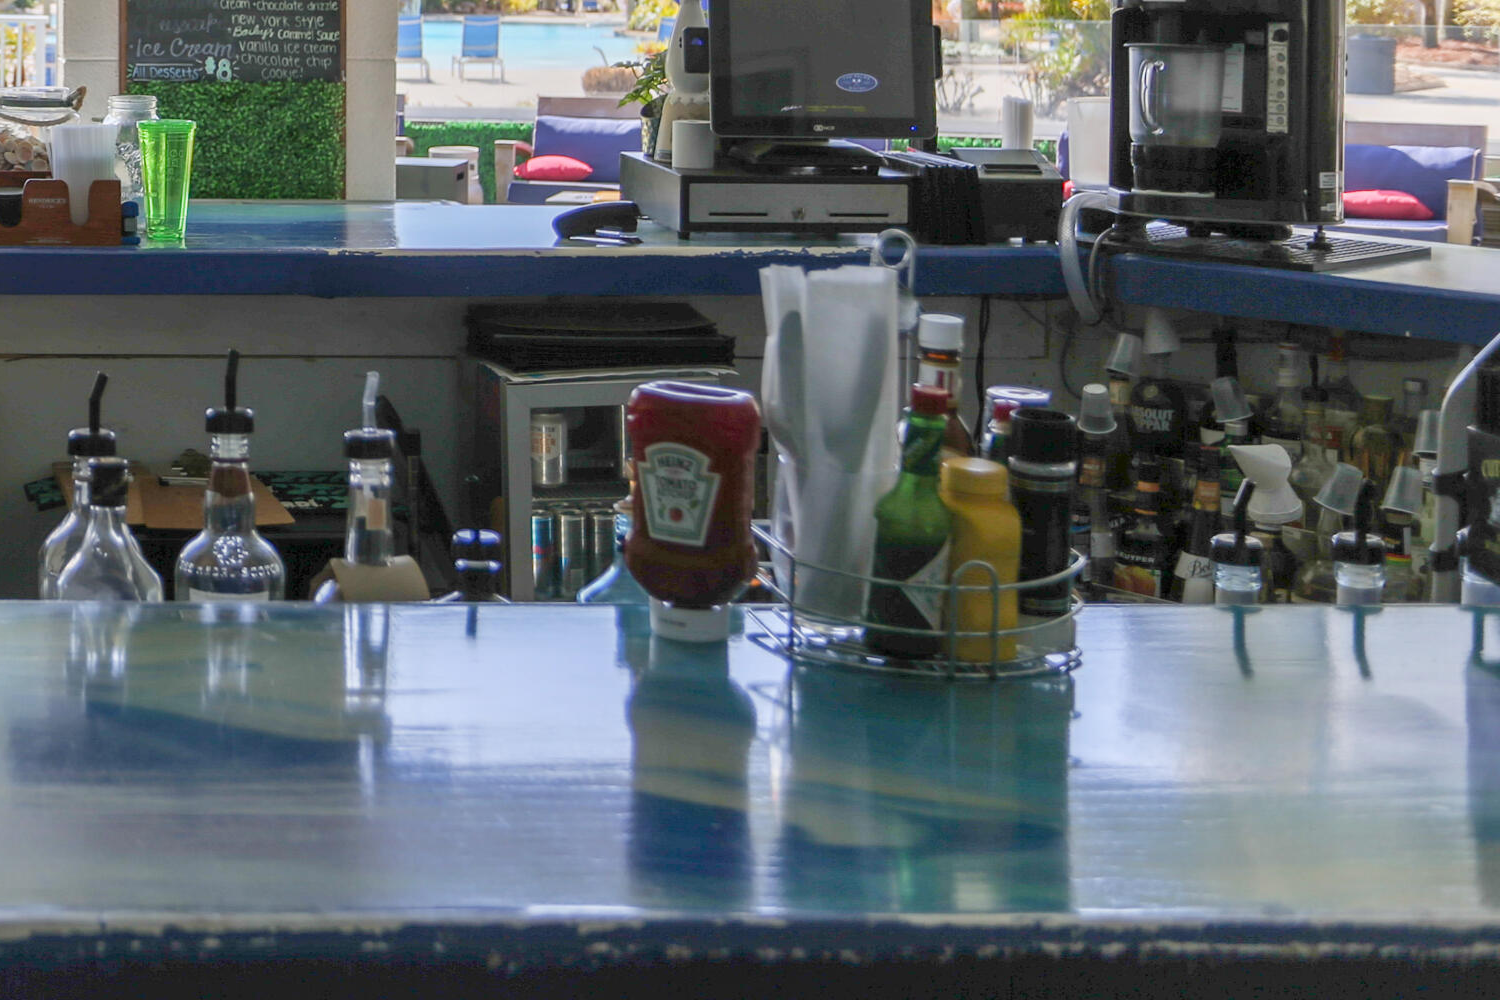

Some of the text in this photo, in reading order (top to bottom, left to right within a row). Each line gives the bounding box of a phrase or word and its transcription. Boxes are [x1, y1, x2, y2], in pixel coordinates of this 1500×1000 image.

[307, 0, 339, 11] drizzle
[231, 14, 256, 25] new
[136, 37, 233, 59] Ice Cream
[306, 56, 332, 70] chip
[132, 65, 200, 80] All Desserts
[657, 455, 693, 472] HEINZ
